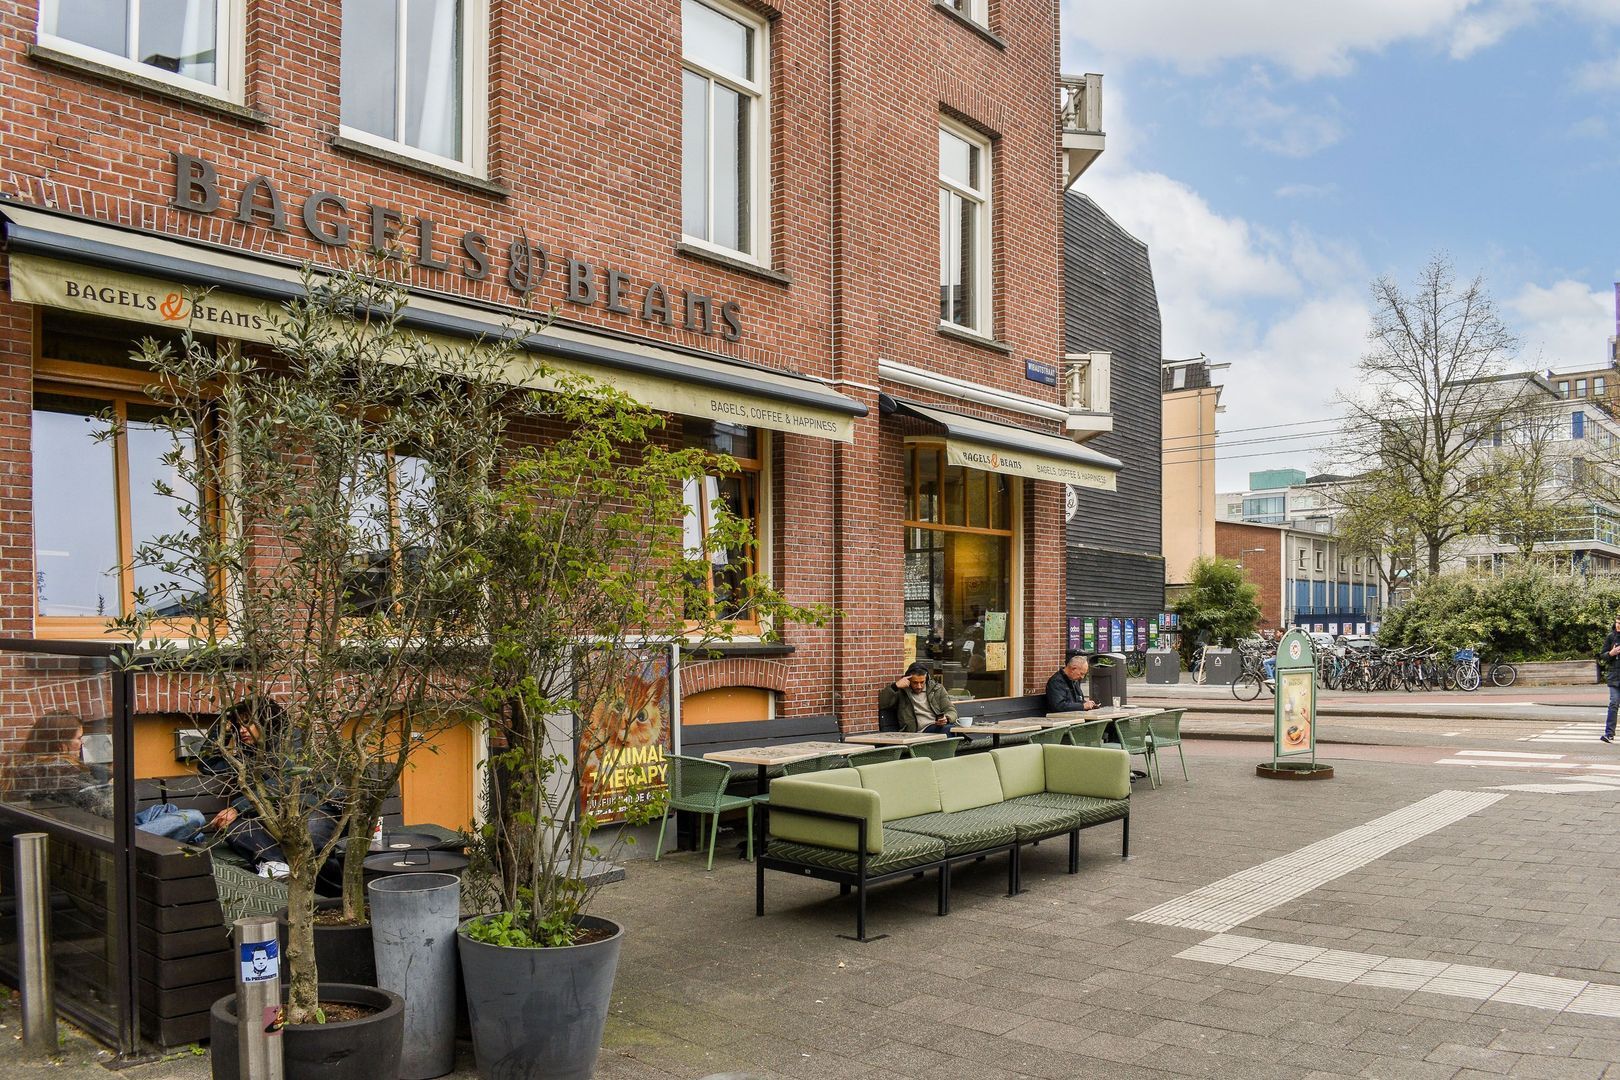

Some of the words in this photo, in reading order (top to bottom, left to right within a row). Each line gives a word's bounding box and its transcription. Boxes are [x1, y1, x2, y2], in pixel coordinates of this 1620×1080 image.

[168, 152, 489, 280] BAGELS
[508, 226, 548, 297] &
[564, 258, 742, 342] BEANS
[65, 281, 157, 311] BAGELS
[159, 290, 191, 322] &
[192, 301, 262, 330] BEANS
[710, 400, 749, 418] BAGELS,
[751, 407, 783, 423] COFFEE
[785, 413, 791, 424] &
[793, 416, 838, 432] HAPPINESS
[963, 452, 990, 464] BAGELS
[1000, 458, 1022, 469] BEANS
[1058, 468, 1077, 479] COFFEE
[602, 744, 667, 768] ANIMAL
